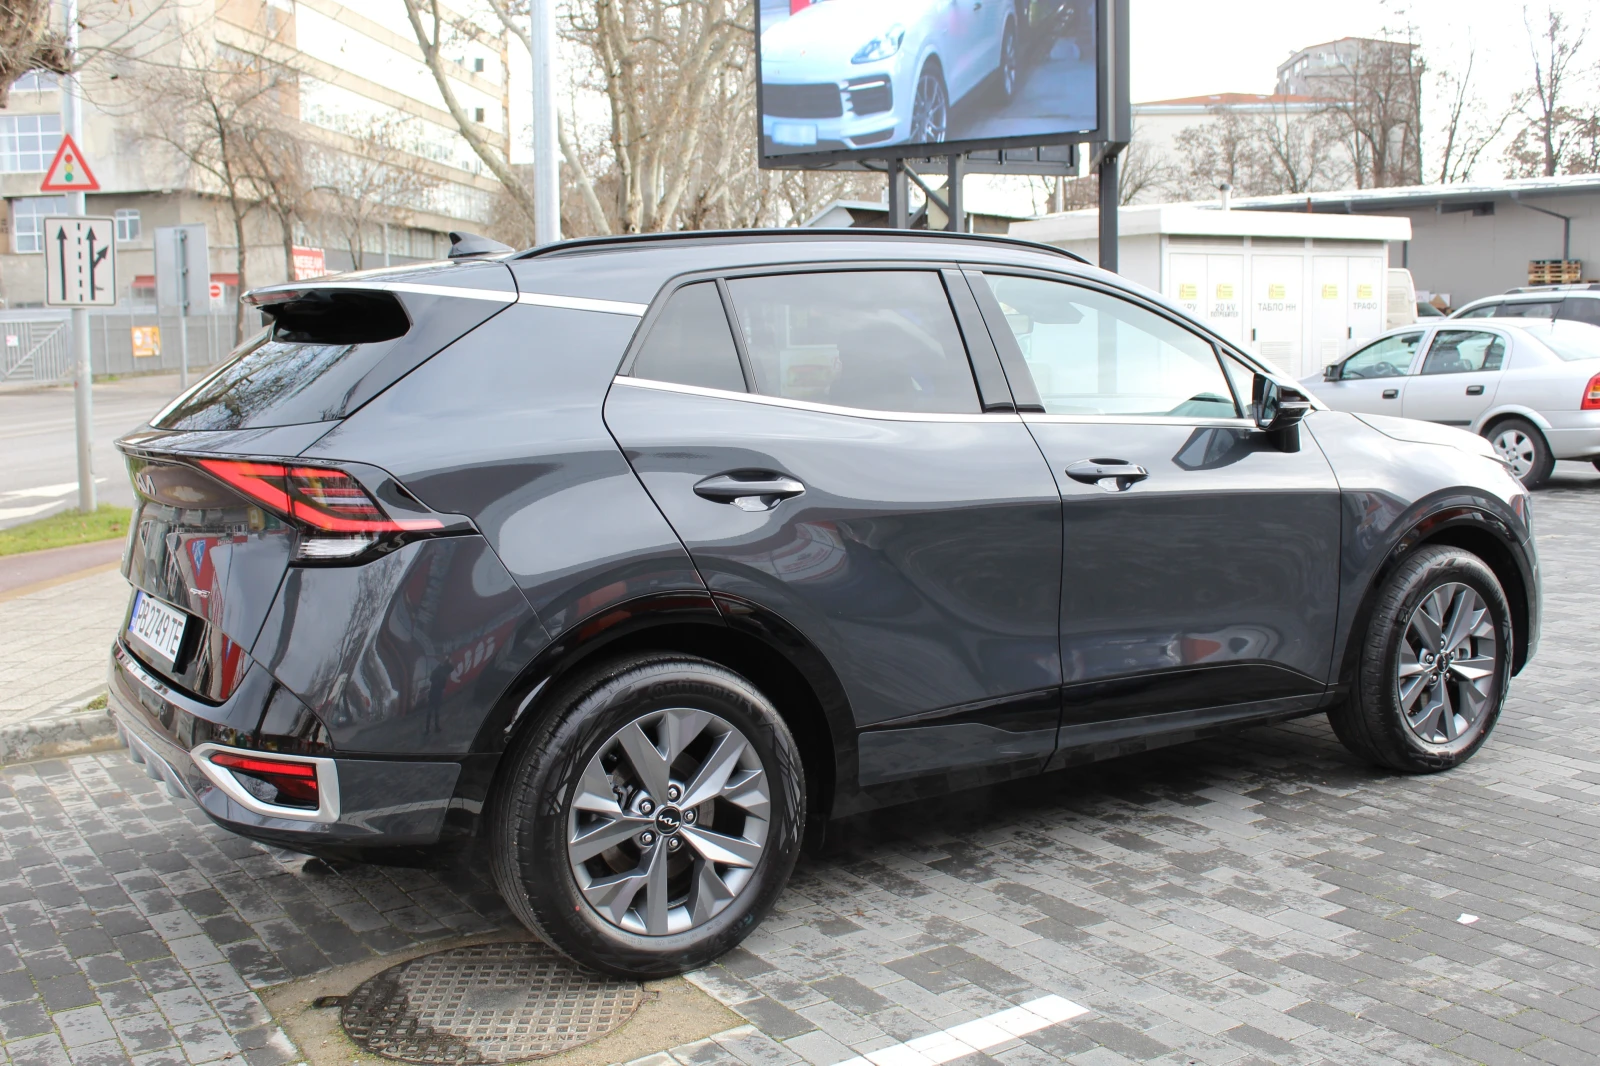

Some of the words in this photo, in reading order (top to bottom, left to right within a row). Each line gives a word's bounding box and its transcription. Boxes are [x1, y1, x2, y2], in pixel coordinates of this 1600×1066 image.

[1183, 303, 1198, 312] РУ
[1215, 303, 1225, 312] 20
[1257, 302, 1284, 312] ТАБЛО
[1353, 302, 1378, 311] ТРАФО
[134, 598, 150, 634] PB
[144, 605, 171, 647] 2749
[165, 617, 184, 657] TE
[645, 681, 753, 715] Continental
